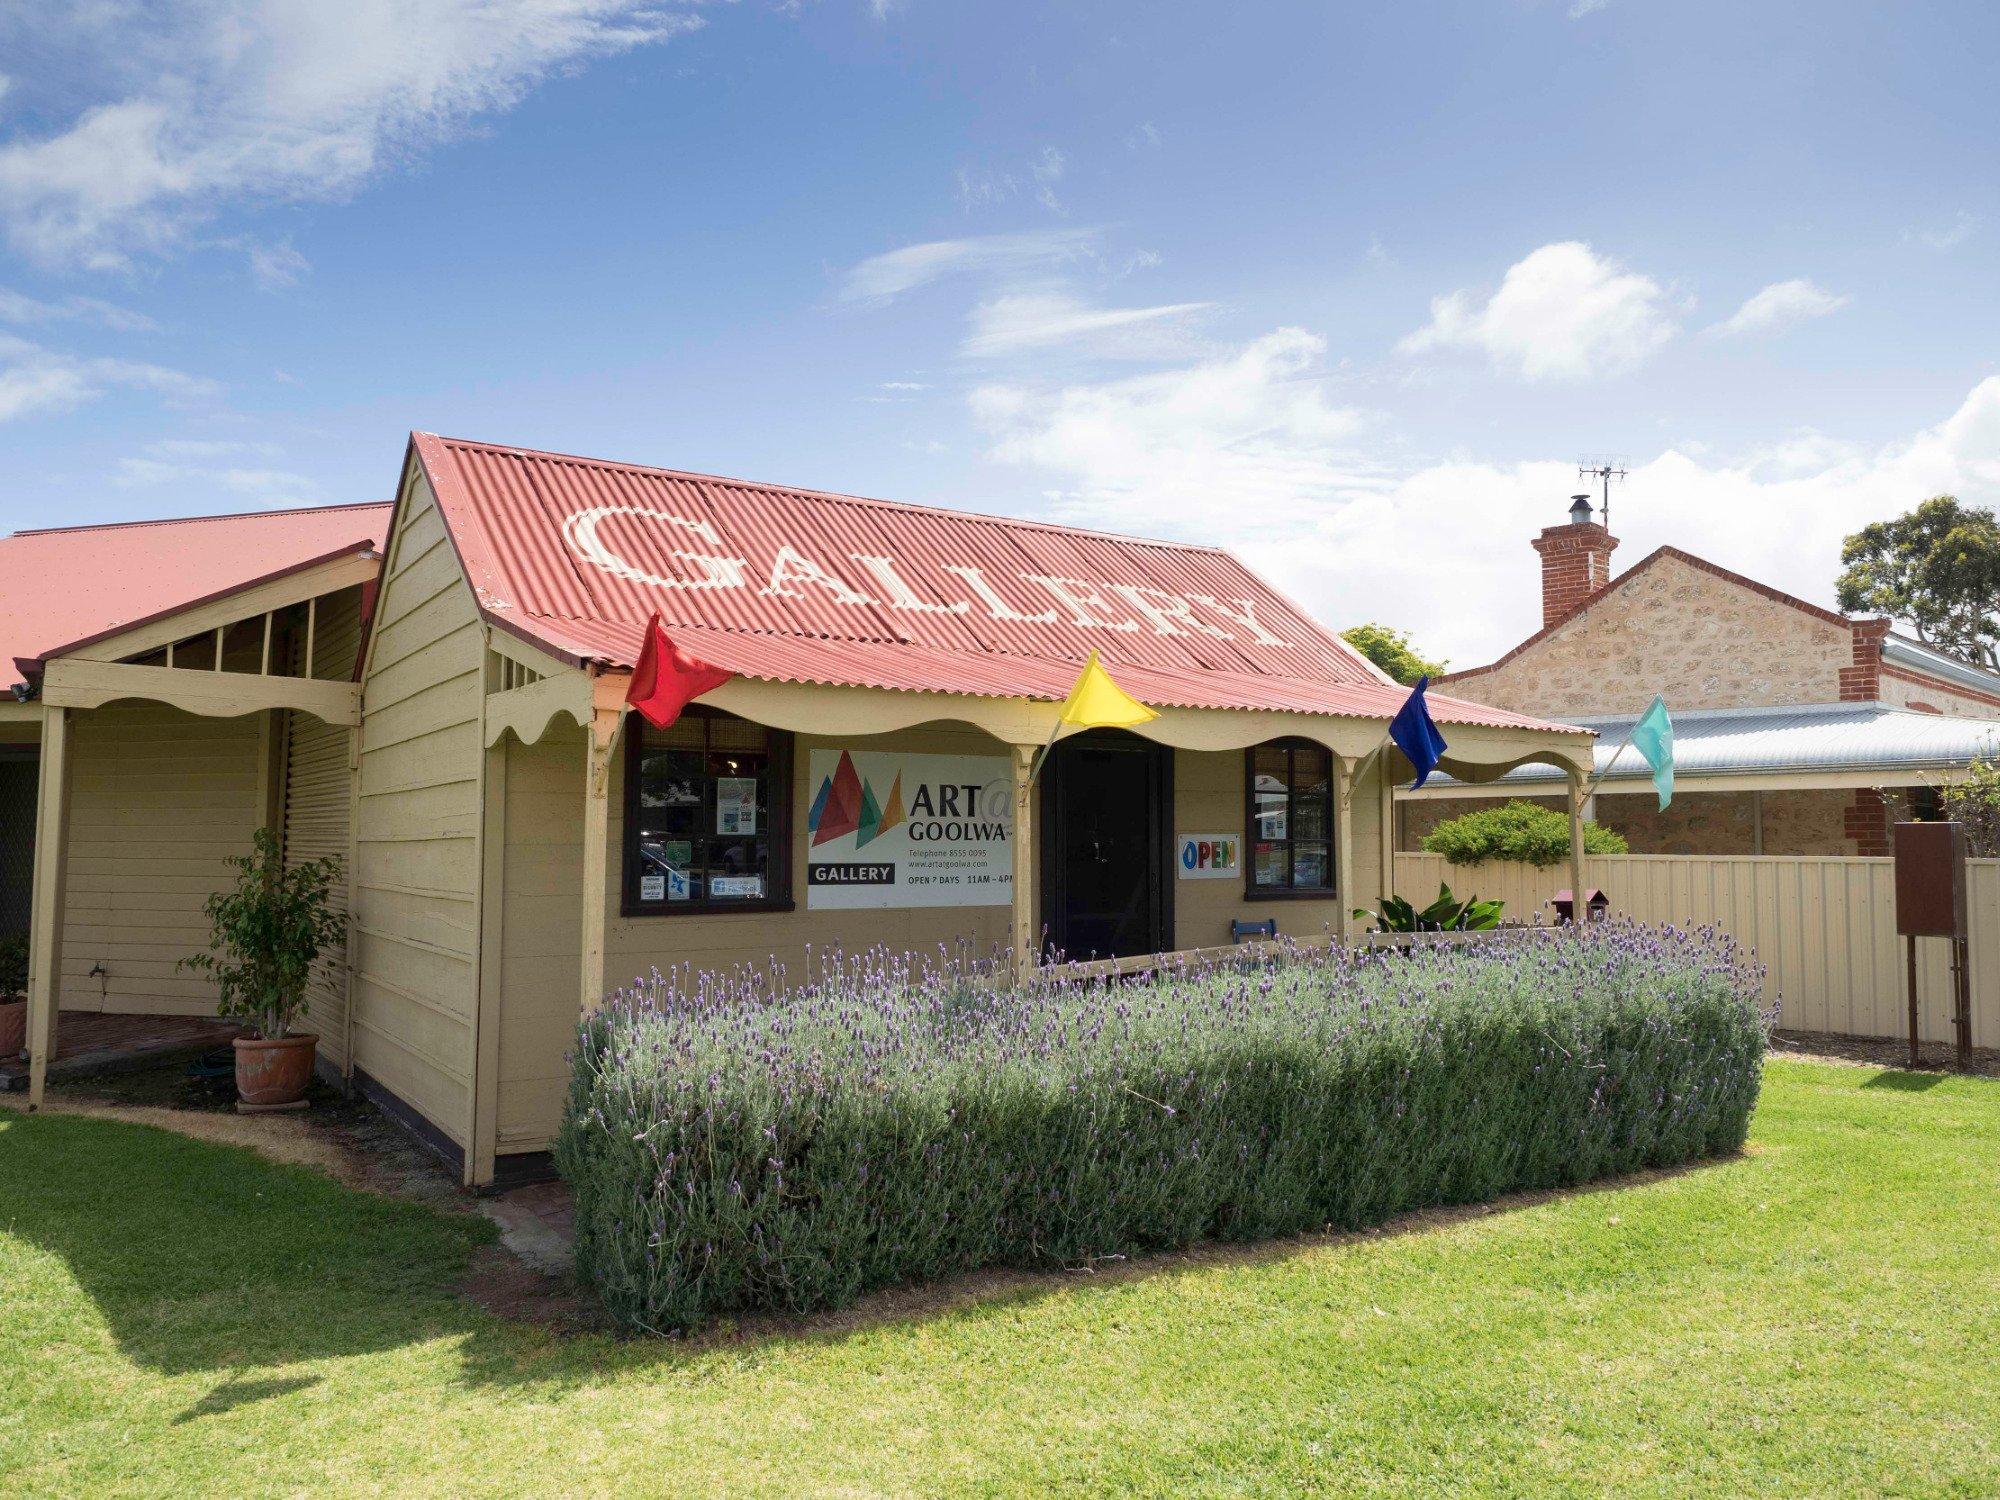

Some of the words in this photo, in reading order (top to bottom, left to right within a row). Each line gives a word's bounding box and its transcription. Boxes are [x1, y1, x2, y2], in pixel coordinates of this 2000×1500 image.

[562, 505, 1294, 648] GALLERY
[908, 821, 1006, 841] GOOLWA
[909, 849, 947, 859] Telephone
[949, 849, 967, 858] 8555
[1182, 840, 1236, 870] OPEN
[908, 859, 988, 869] www.artatgoolwa.com
[815, 867, 891, 881] GALLERY
[908, 876, 930, 885] OPEN
[940, 875, 960, 884] DAYS
[967, 875, 990, 884] 11AM
